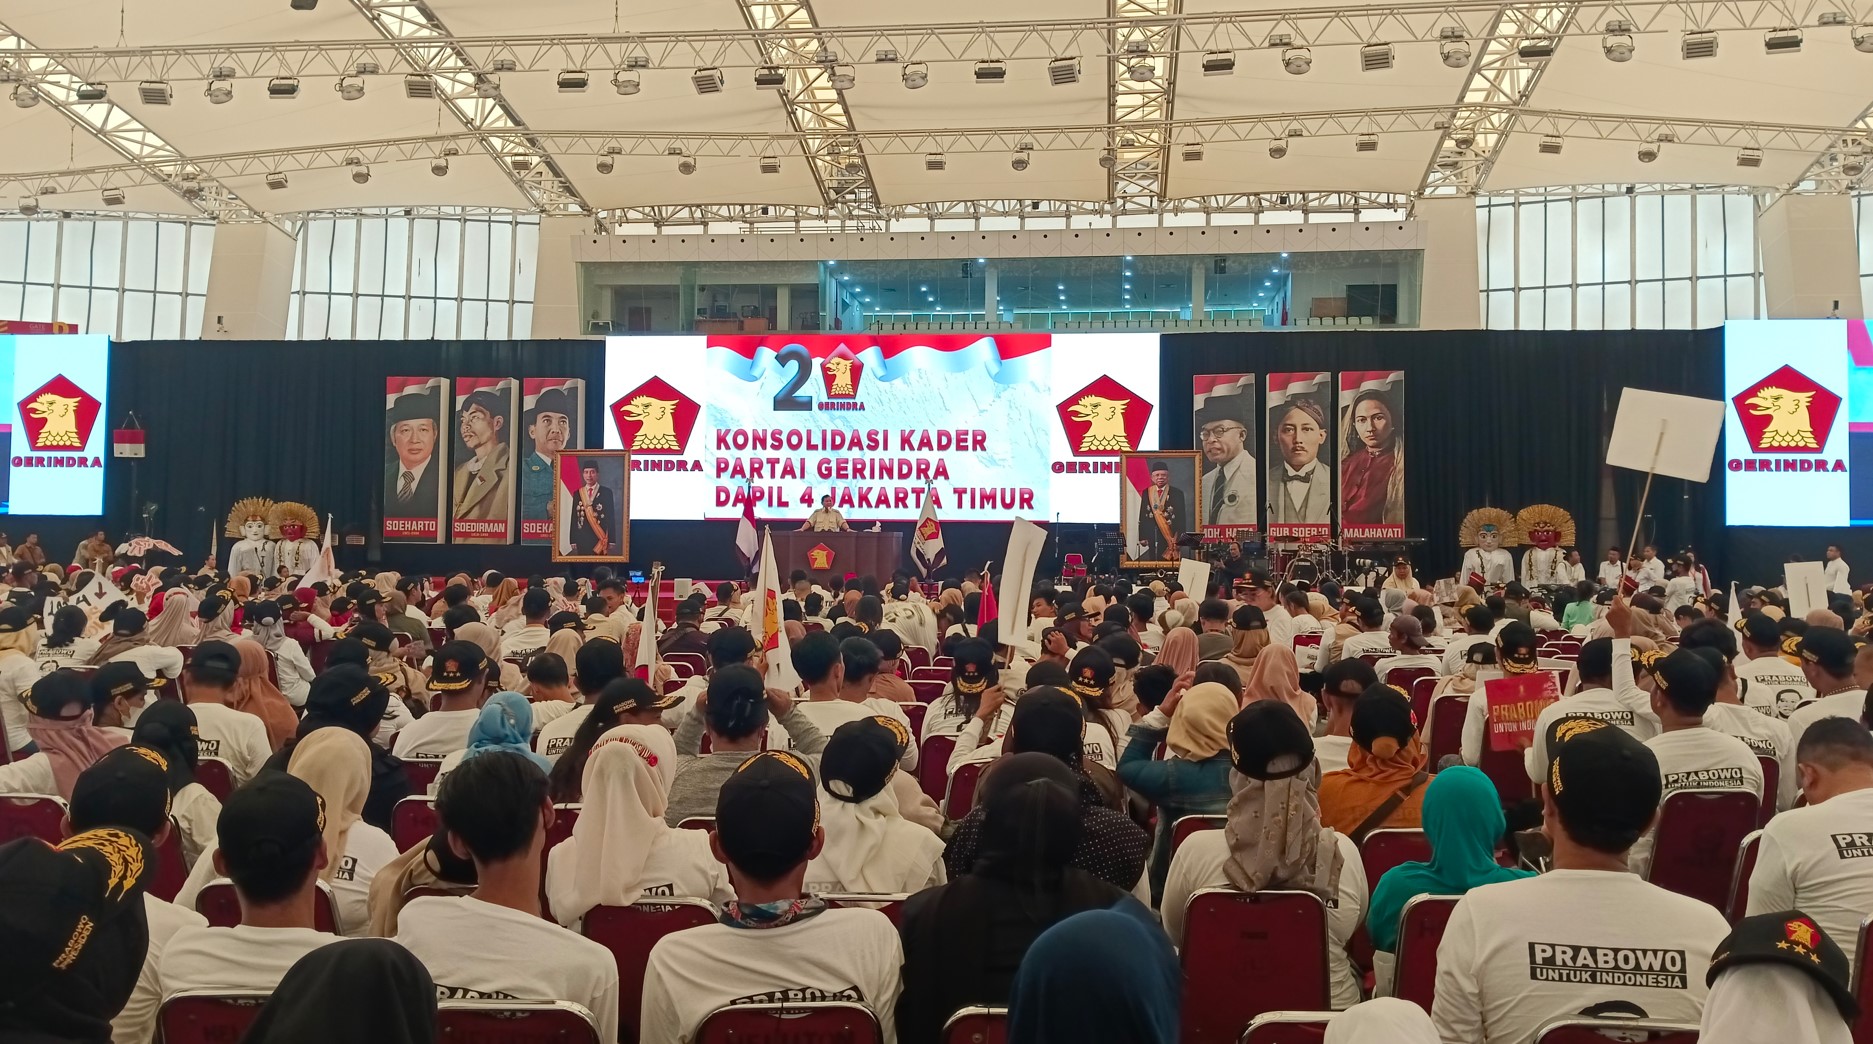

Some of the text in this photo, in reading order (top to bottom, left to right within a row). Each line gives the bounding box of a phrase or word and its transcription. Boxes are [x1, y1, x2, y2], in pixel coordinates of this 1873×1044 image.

[773, 344, 812, 411] 2
[817, 401, 866, 411] GERINDRA
[716, 429, 987, 451] KONSOLIDASI KADER
[11, 456, 103, 468] GERINDRA
[630, 459, 704, 471] RINDRA
[716, 457, 950, 480] PARTAI GERINDRA
[1727, 458, 1848, 472] GERINDRA
[716, 486, 1035, 510] DAPIL 4 JAKARTA TIMUR
[386, 520, 436, 531] SOEHARTO
[454, 522, 505, 533] SOEDIRMAN
[523, 523, 552, 533] SOEKA
[1343, 527, 1401, 538] MALAHAYATI
[1667, 768, 1742, 783] PRABOWO
[1700, 779, 1742, 787] INDONESIA
[1534, 943, 1682, 972] PRABOWO
[1536, 967, 1683, 988] UNTUK INDONESIA
